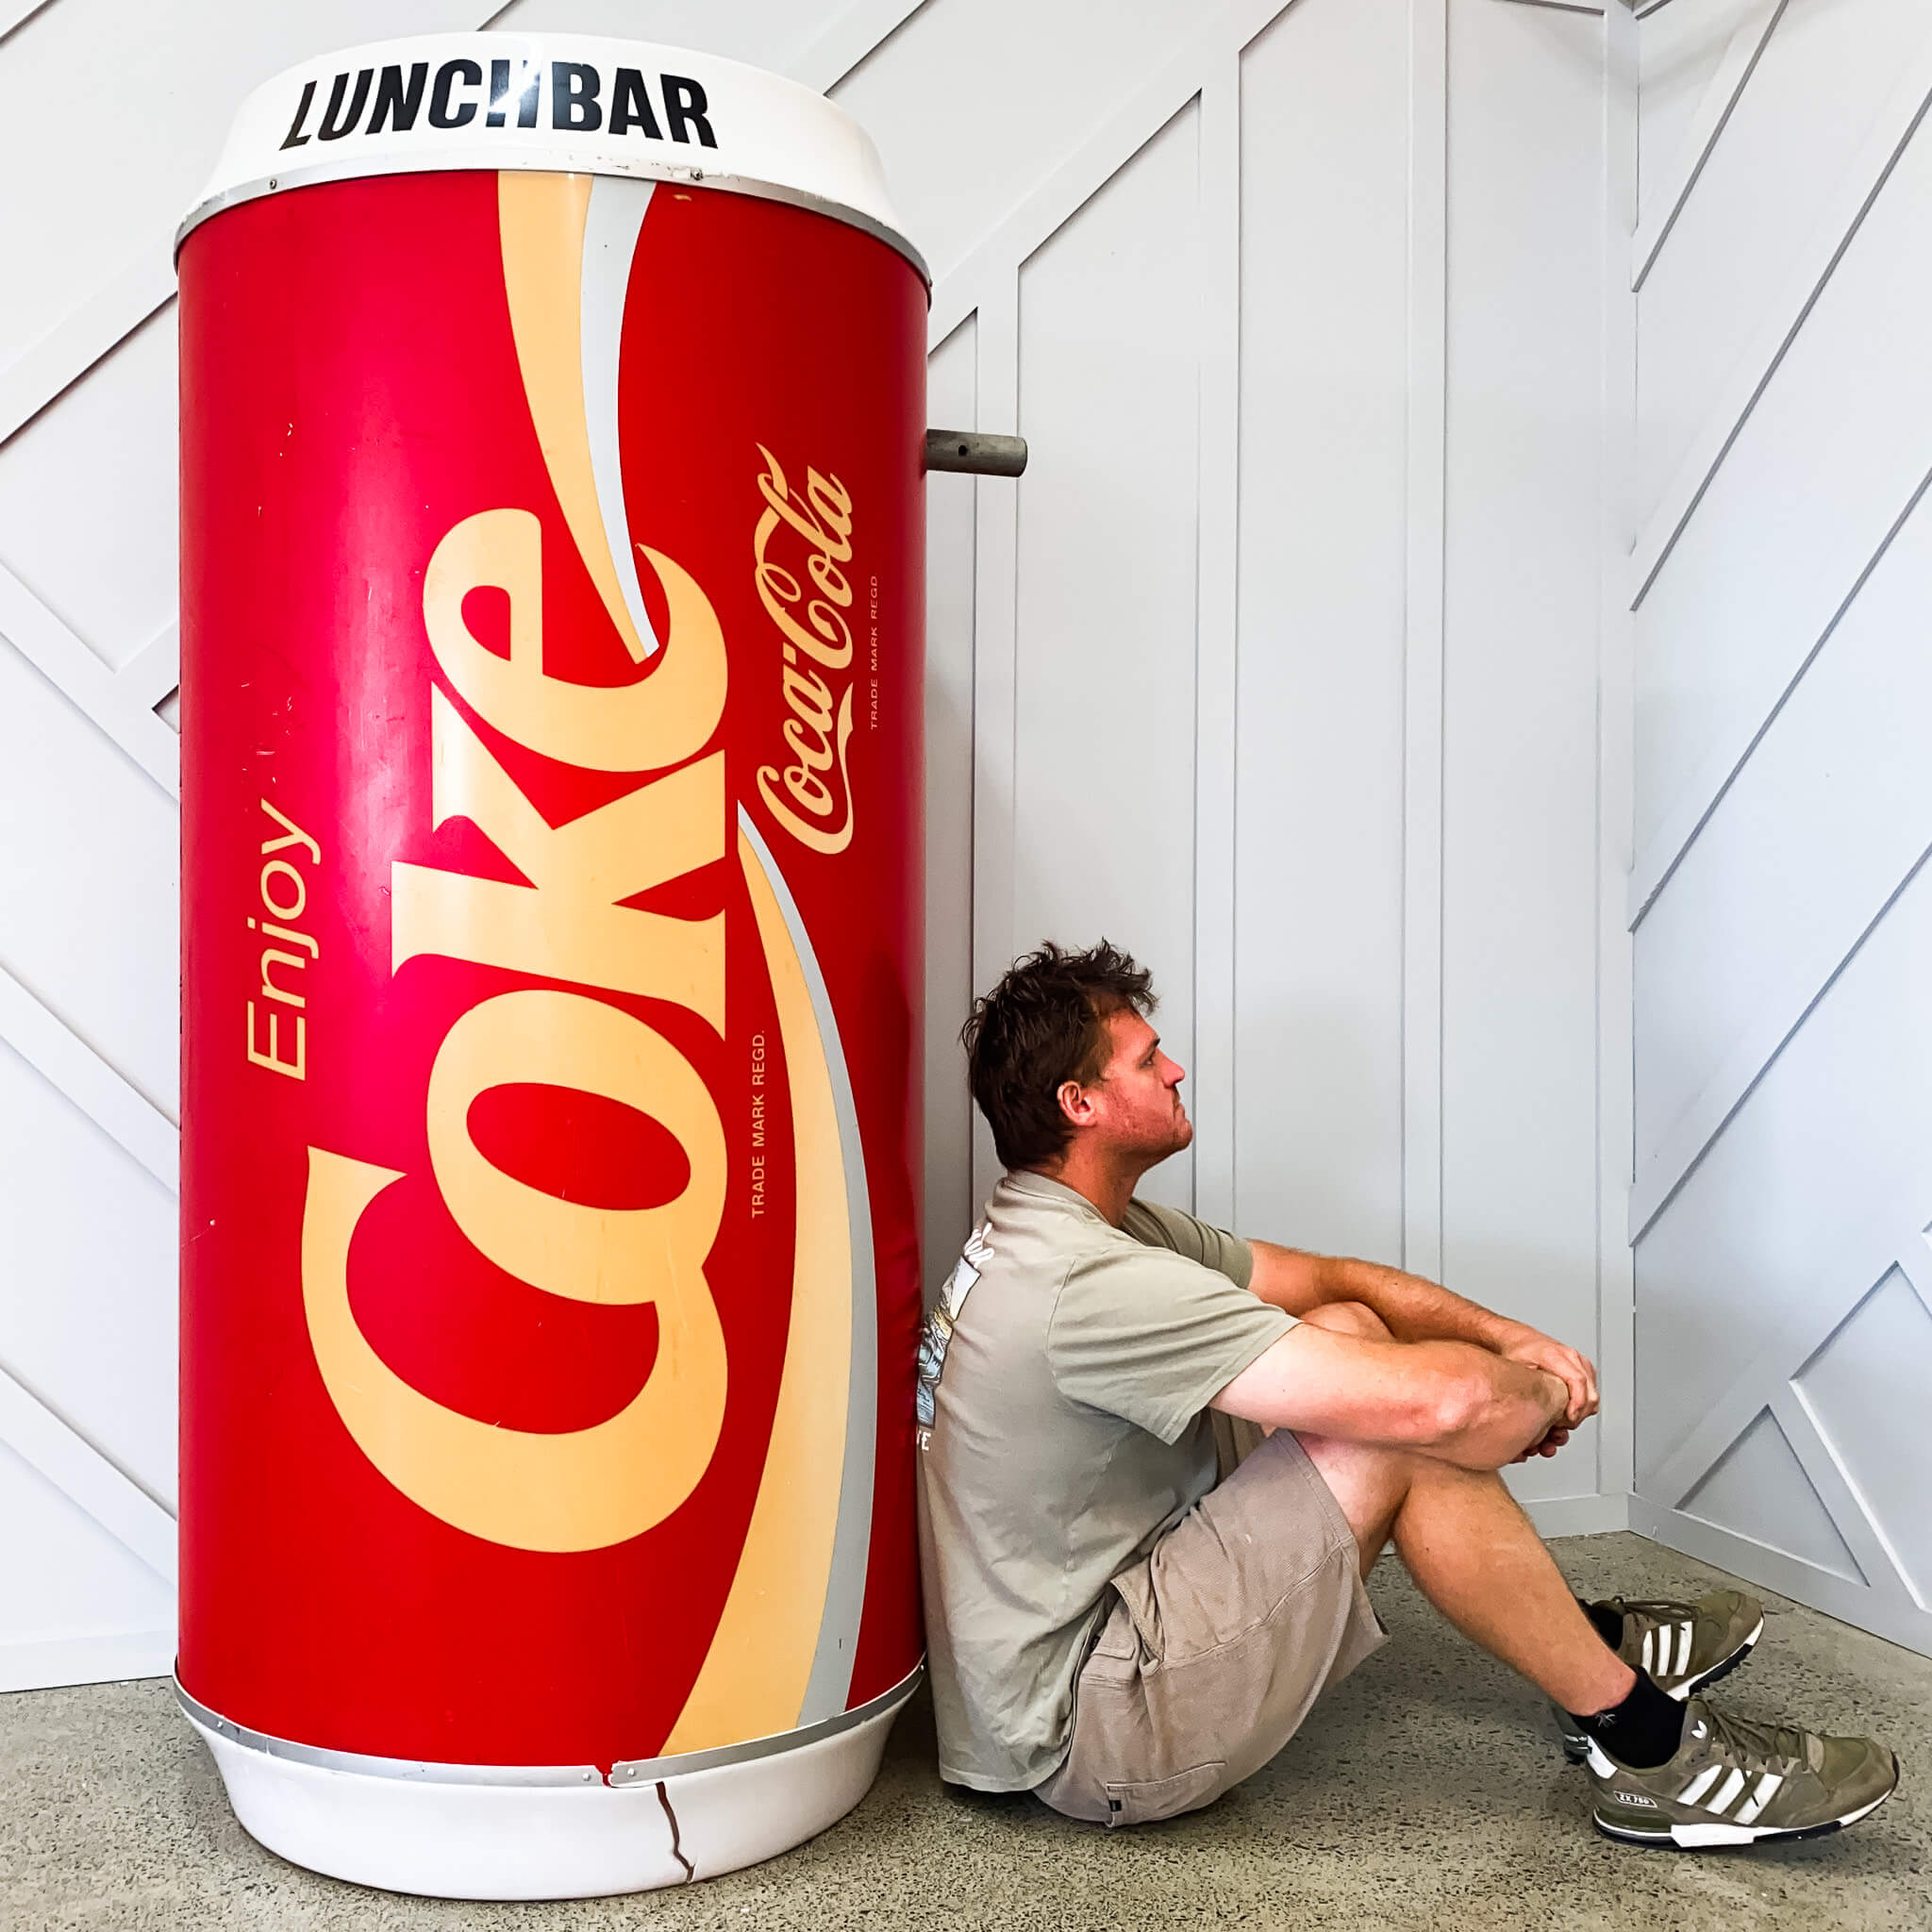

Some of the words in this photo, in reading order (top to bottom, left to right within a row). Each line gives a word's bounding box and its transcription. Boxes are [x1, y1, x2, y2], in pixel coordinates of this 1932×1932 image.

[279, 58, 719, 151] LUNCHBAR
[754, 442, 854, 855] Coca-Cola
[870, 626, 878, 672] MARK
[870, 678, 878, 730] TRADE
[247, 797, 322, 1081] Enjoy
[301, 508, 729, 1553] Coke
[752, 1029, 765, 1086] REGD.
[752, 1093, 765, 1147] MARK
[751, 1155, 765, 1220] TRADE
